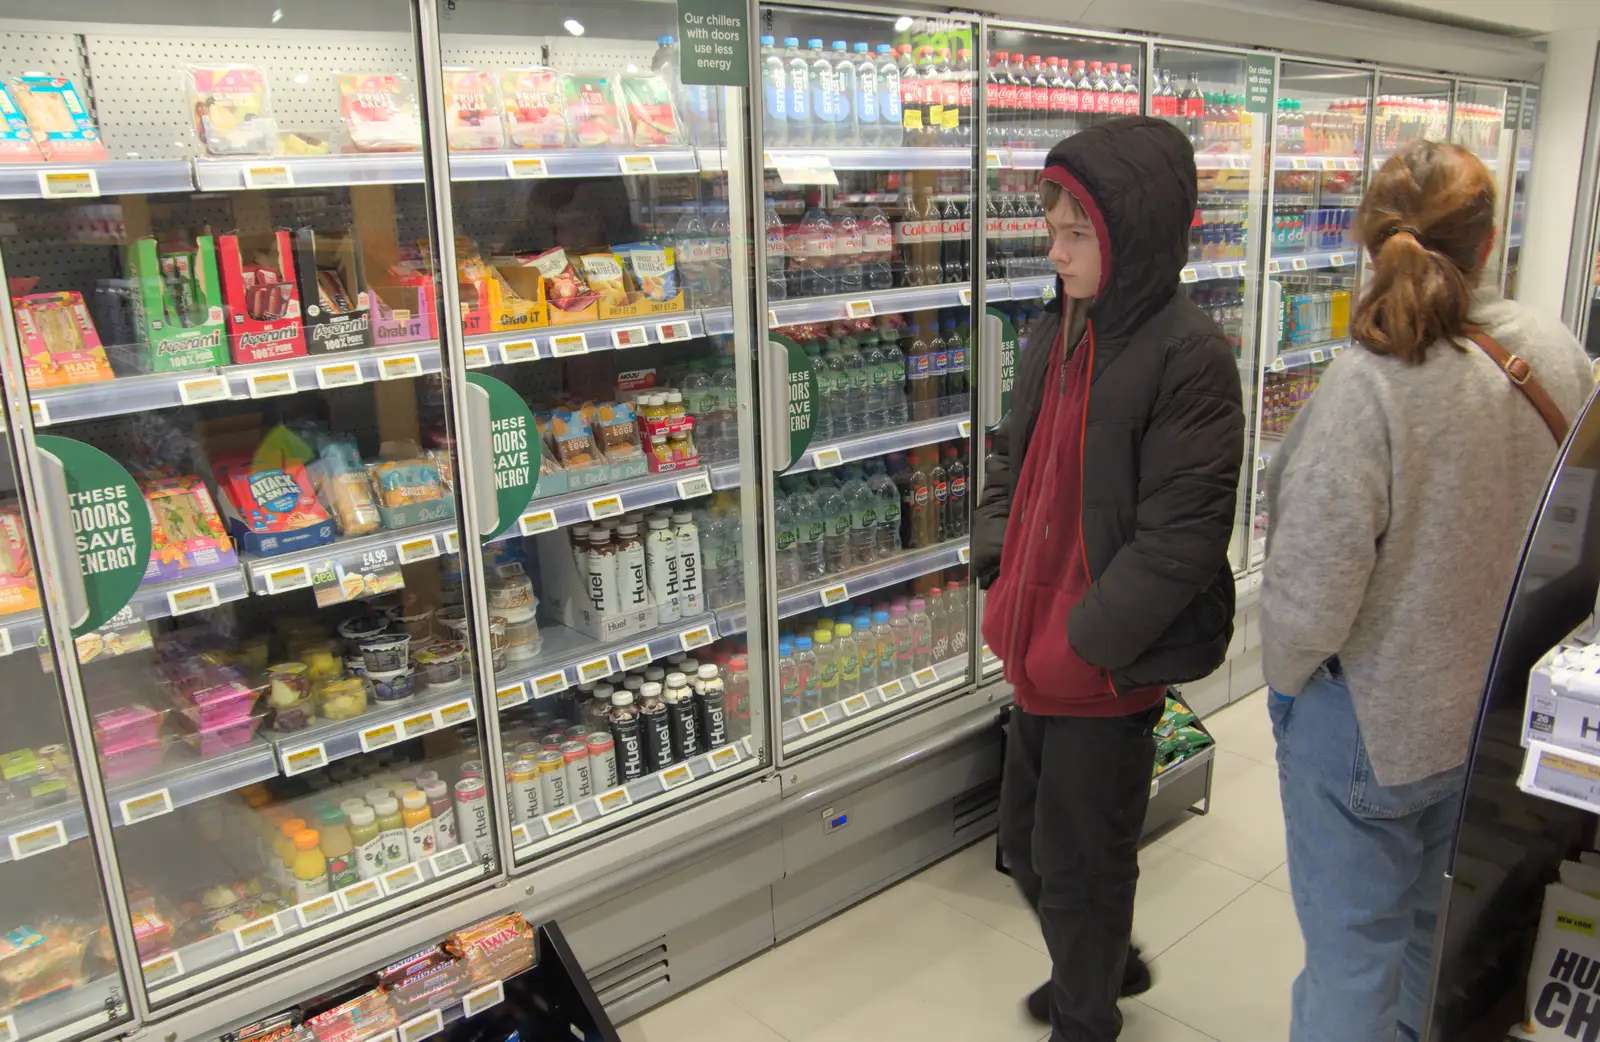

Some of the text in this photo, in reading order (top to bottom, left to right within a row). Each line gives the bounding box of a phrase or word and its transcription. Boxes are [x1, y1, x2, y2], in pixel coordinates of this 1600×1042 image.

[684, 12, 741, 27] Our chillers
[687, 28, 740, 41] with doors
[694, 43, 734, 55] use less
[697, 59, 732, 71] energy
[356, 93, 391, 101] FRUIT
[452, 94, 486, 102] FRUIT
[516, 92, 548, 100] FRUIT
[792, 68, 805, 113] smart
[861, 72, 874, 115] smart
[887, 73, 898, 115] smart
[516, 100, 549, 109] SALAD
[239, 321, 300, 350] Peperami
[312, 312, 369, 341] Peperami
[377, 324, 407, 339] Grab
[157, 328, 222, 357] Peperami
[324, 338, 348, 351] 100%
[1002, 340, 1014, 350] ESE
[168, 354, 195, 367] 100%
[251, 346, 276, 360] 100%
[64, 361, 97, 373] HAM
[619, 372, 640, 380] MOJU
[788, 382, 810, 401] OORS
[1002, 378, 1014, 392] RGY
[789, 401, 811, 413] AVE
[491, 416, 526, 432] HESE
[613, 426, 633, 436] EGGS
[790, 414, 811, 432] ERGY
[493, 429, 527, 454] OORS
[568, 440, 590, 451] EGGS
[493, 452, 529, 470] AVE
[659, 463, 676, 471] MOJU
[250, 474, 297, 500] ATTACK
[495, 466, 530, 490] NERGY
[68, 485, 128, 507] THESE
[258, 497, 267, 507] A
[266, 486, 300, 501] SNAK
[71, 501, 131, 534] DOORS
[419, 504, 448, 522] Deli
[76, 527, 135, 552] SAVE
[79, 544, 137, 576] ENERGY
[362, 549, 389, 566] £4.99
[665, 556, 679, 596] Huel
[681, 552, 697, 591] Huel
[588, 572, 605, 612] Huel
[630, 563, 646, 604] Huel
[607, 618, 627, 632] Huel
[708, 707, 726, 749] Huel
[1537, 714, 1549, 724] 26
[681, 714, 697, 756] Huel
[622, 735, 641, 775] Huel
[656, 724, 672, 769] Huel
[577, 766, 590, 798] Huel
[605, 757, 616, 788] Huel
[524, 787, 540, 819] Huel
[551, 777, 565, 809] Huel
[473, 805, 488, 838] Huel
[1557, 915, 1593, 929] NEW LOOK
[473, 925, 520, 956] TWIX
[387, 945, 436, 971] SNICKERS
